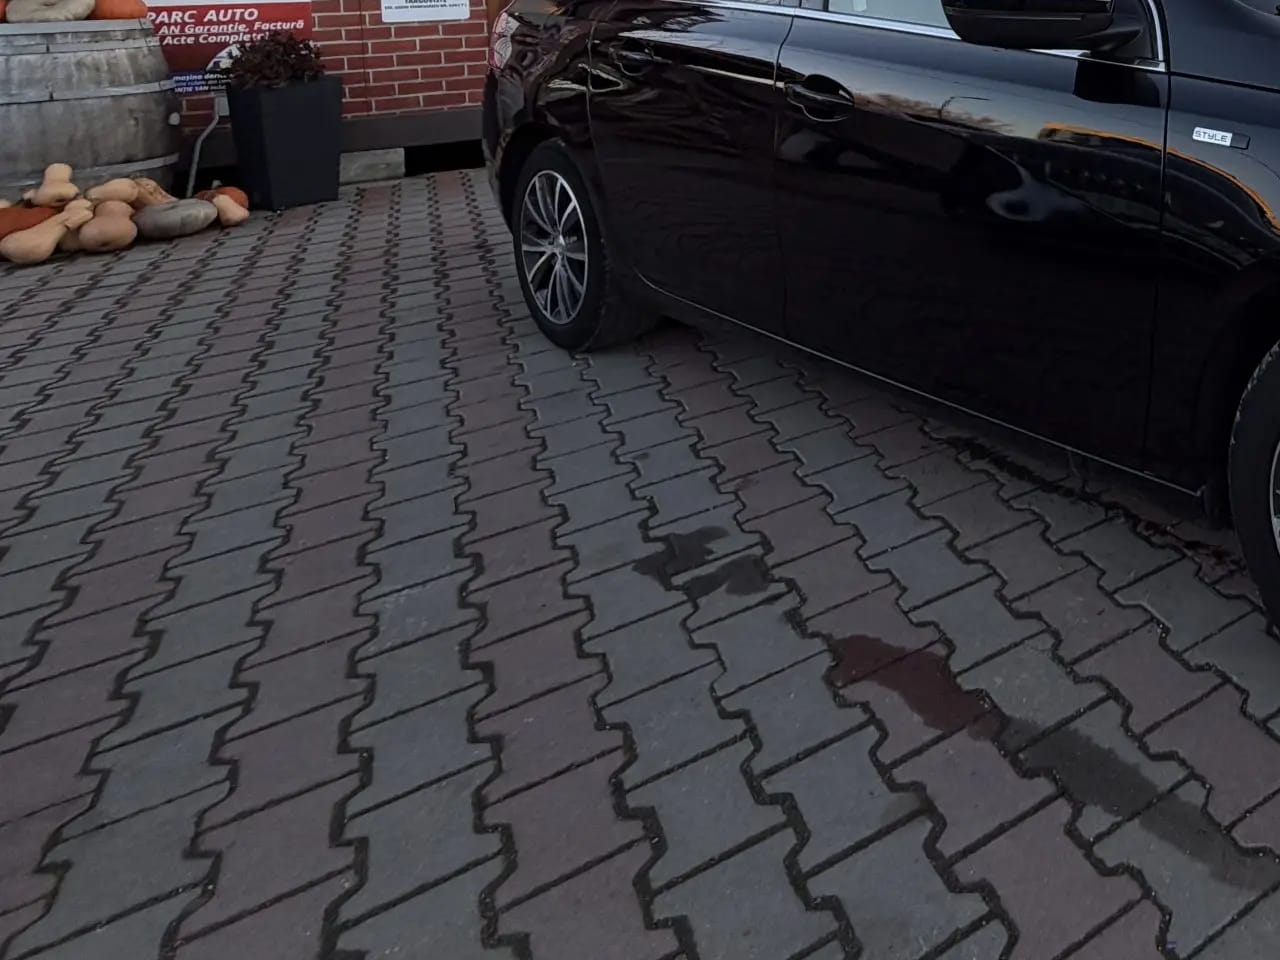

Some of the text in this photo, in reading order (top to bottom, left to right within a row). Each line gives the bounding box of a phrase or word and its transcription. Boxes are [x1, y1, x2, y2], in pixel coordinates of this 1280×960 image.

[203, 8, 259, 22] AUTO
[158, 24, 182, 35] AN
[253, 19, 305, 30] Factură
[162, 35, 195, 45] Acte
[1195, 130, 1228, 143] STYLE
